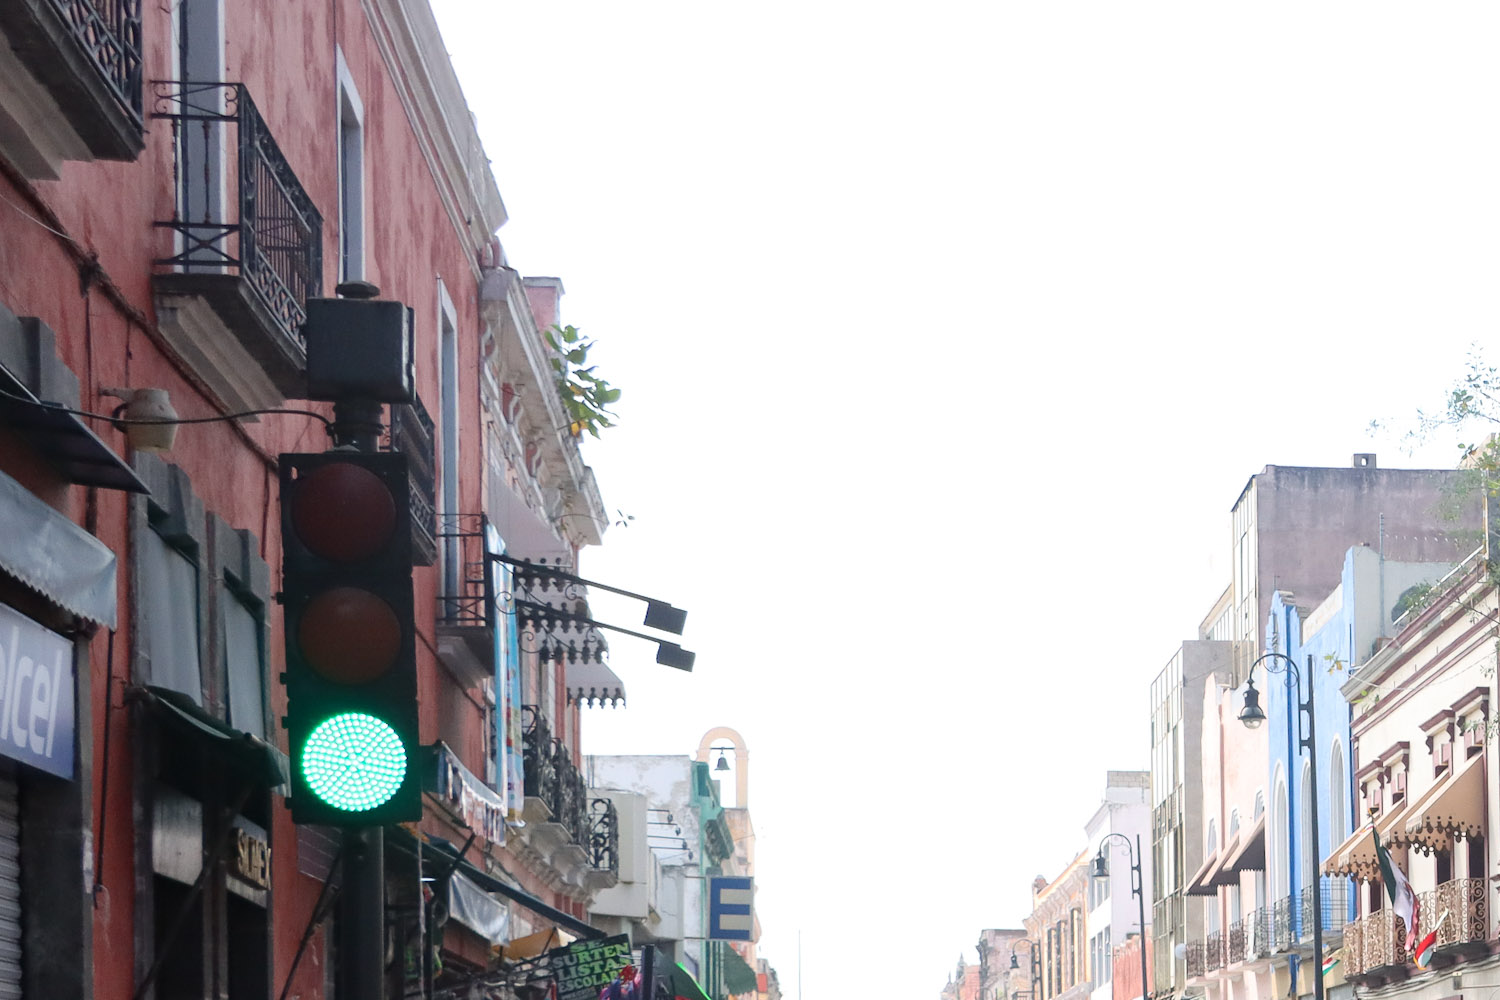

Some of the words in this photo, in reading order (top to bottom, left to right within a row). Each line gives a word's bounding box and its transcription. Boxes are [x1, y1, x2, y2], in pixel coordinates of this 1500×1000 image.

[0, 626, 63, 759] lcel
[709, 877, 751, 940] E
[552, 942, 630, 969] SURTEN
[556, 957, 632, 981] LISTAS
[558, 968, 626, 994] ESCOLAR
